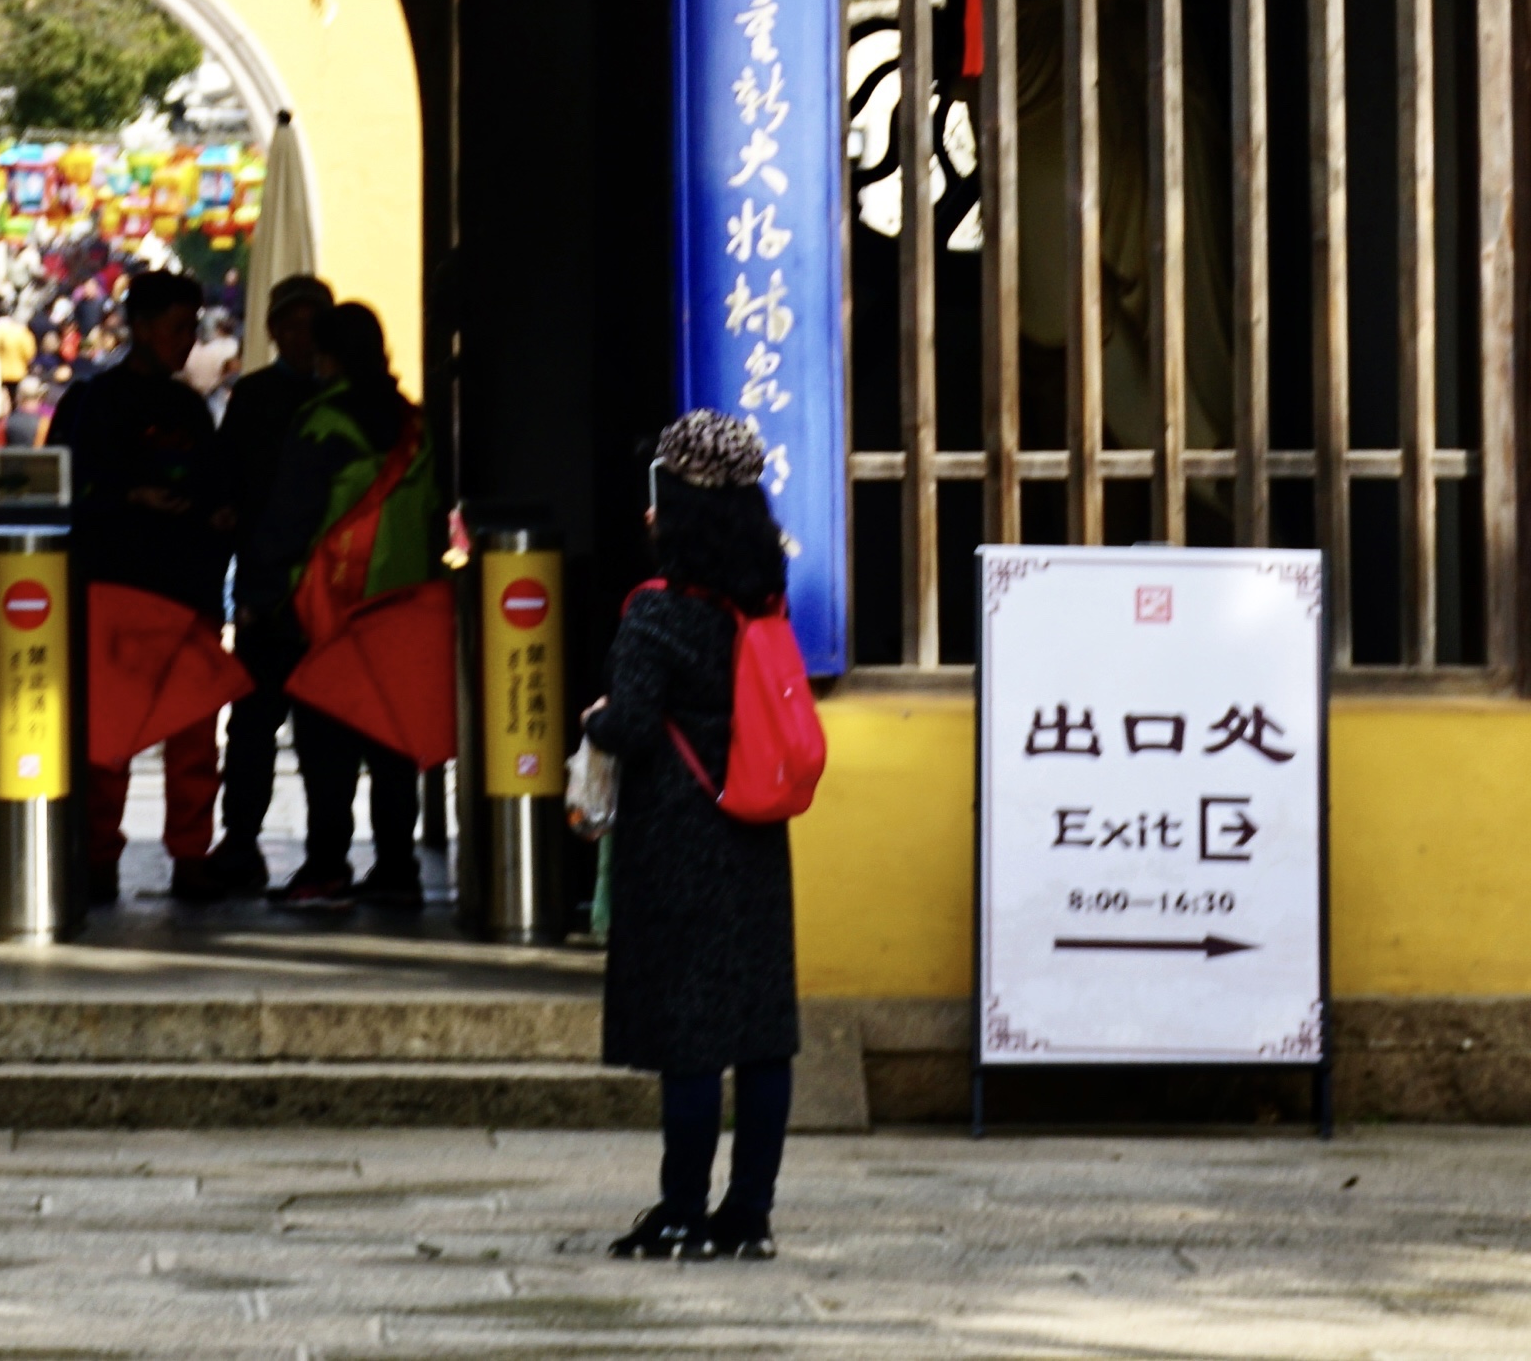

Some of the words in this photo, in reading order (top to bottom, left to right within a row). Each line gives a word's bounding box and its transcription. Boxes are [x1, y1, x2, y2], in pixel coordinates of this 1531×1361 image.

[1024, 699, 1297, 763] 出口处
[1051, 807, 1184, 850] Exit
